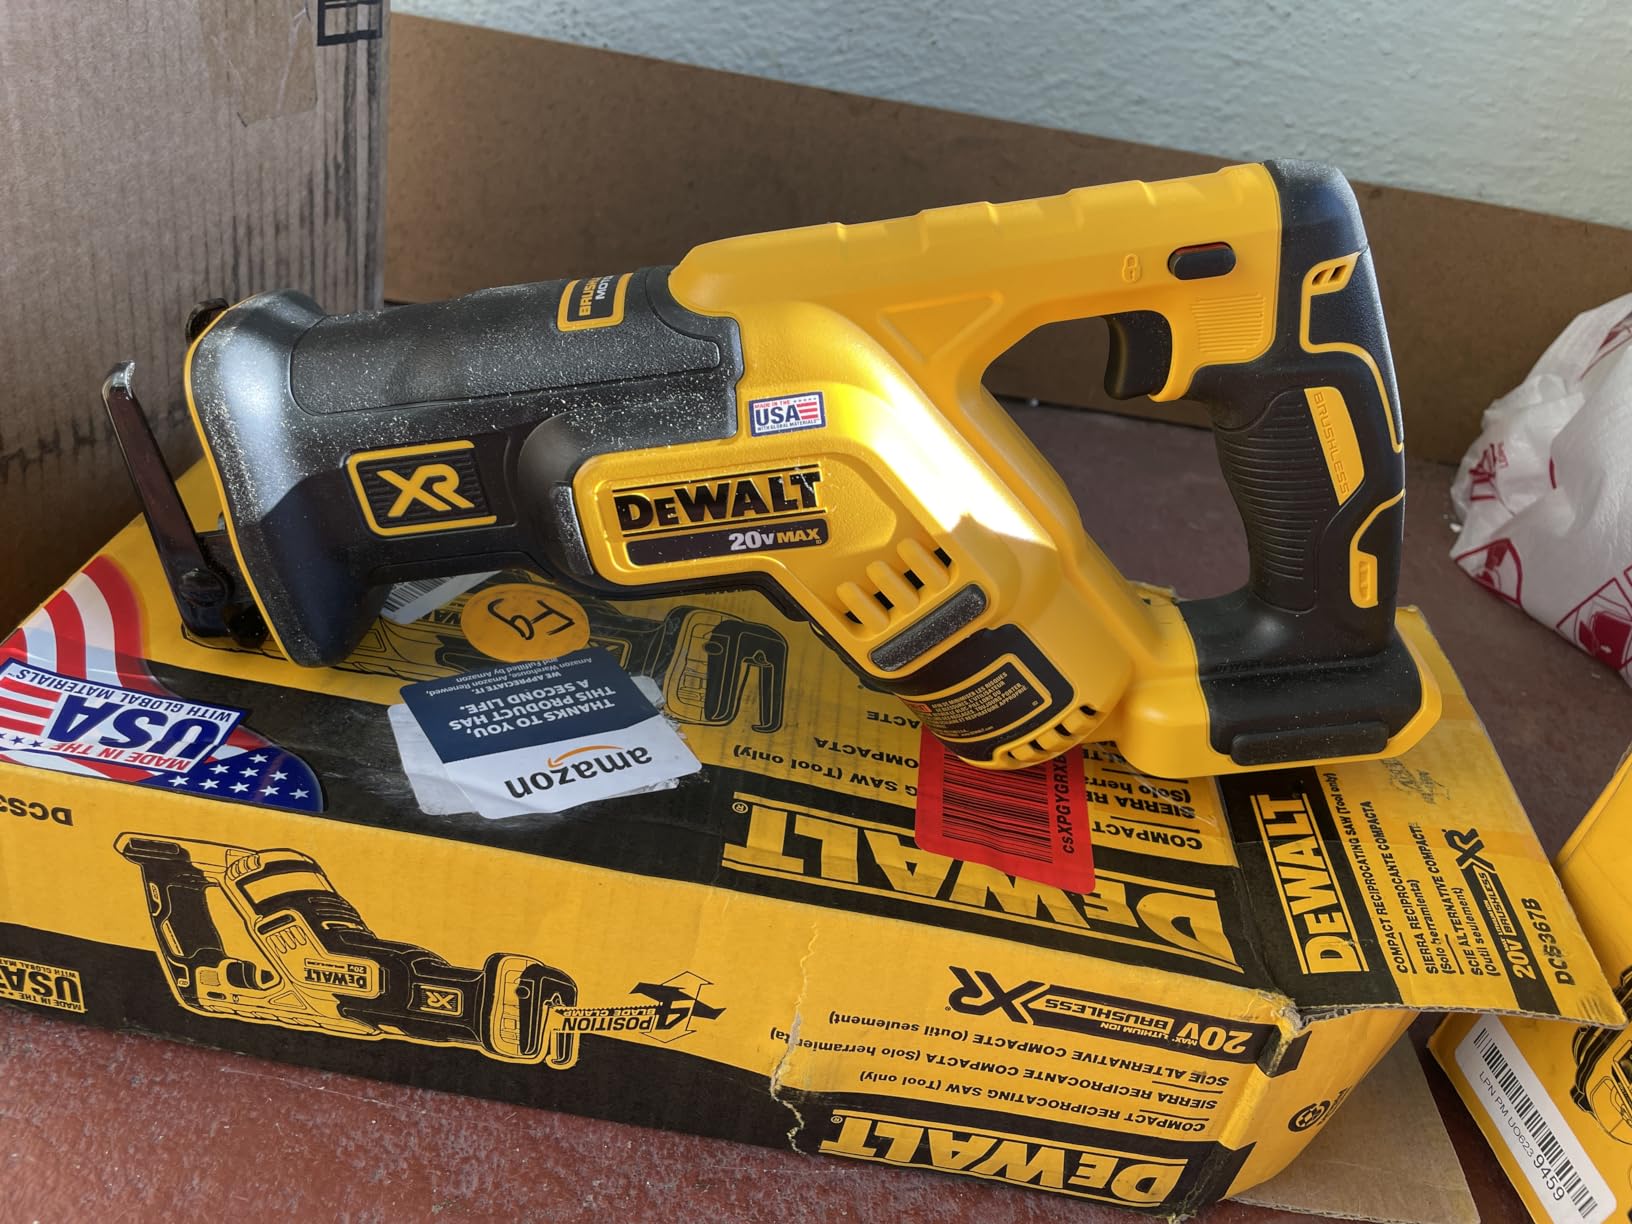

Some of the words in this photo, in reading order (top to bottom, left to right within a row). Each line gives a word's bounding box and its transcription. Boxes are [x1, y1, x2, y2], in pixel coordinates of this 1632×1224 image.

[755, 404, 800, 427] USA
[1313, 391, 1350, 494] BRUSHLESS
[377, 463, 478, 518] XR
[613, 471, 823, 532] DEWALT
[776, 528, 820, 544] MAX
[493, 666, 505, 675] by
[511, 663, 560, 680] Warehouse,
[558, 657, 592, 670] Amazon
[15, 669, 114, 699] MATERIALS
[456, 670, 493, 683] Amazon
[475, 674, 509, 688] Amazon
[485, 673, 544, 693] APPRECIATE
[543, 671, 563, 680] WE
[575, 679, 590, 689] A
[984, 671, 1008, 689] RISQUES
[426, 683, 474, 697] Renewed,
[471, 686, 486, 696] IT.
[506, 682, 577, 704] SECOND
[579, 685, 616, 703] THIS
[119, 692, 185, 713] GLOBAL
[459, 696, 505, 714] LIFE.
[492, 695, 575, 721] PRODUCT
[544, 698, 616, 721] THANKS
[186, 706, 233, 722] WITH
[448, 713, 490, 731] HAS
[516, 713, 544, 728] TO
[47, 694, 221, 760] USA
[466, 722, 516, 738] YOU,
[49, 742, 94, 755] THE
[97, 747, 125, 760] IN
[733, 744, 784, 765] only)
[813, 737, 919, 768] OMPACTA
[128, 751, 192, 771] MADE
[504, 745, 653, 799] amazon
[791, 758, 843, 780] (Tool
[849, 773, 899, 792] SAW
[1323, 772, 1340, 793] only)
[1114, 796, 1196, 819] SIERRA
[1331, 793, 1351, 815] (Tool
[1091, 820, 1203, 850] COMPACT
[1339, 815, 1357, 836] SAW
[1359, 800, 1390, 851] COMPACTA
[1444, 828, 1496, 872] XR
[723, 805, 1238, 967] DEWALT
[1258, 793, 1363, 974] DEWALT
[1348, 837, 1388, 916] RECIPROCATING
[1381, 852, 1422, 931] RECIPROCANTE
[1406, 879, 1441, 945] herramienta)
[1431, 876, 1472, 948] ALTERNATIVE
[1478, 872, 1514, 935] BRUSHLESS
[1451, 887, 1484, 945] seulement)
[1378, 917, 1408, 974] COMPACT
[1520, 897, 1577, 985] DCS367B
[1414, 933, 1439, 975] SIERRA
[1436, 947, 1456, 974] (Solo
[1463, 949, 1484, 976] SCIE
[1477, 947, 1502, 976] (Outil
[1506, 938, 1537, 980] 20V
[0, 965, 81, 1004] USA
[54, 969, 77, 979] WITH
[304, 968, 368, 990] DEWALT
[18, 992, 39, 1002] THE
[41, 996, 51, 1005] IN
[54, 999, 82, 1011] MADE
[425, 990, 455, 1009] XR
[948, 965, 1046, 1025] XR
[562, 1008, 613, 1018] CLAMP
[613, 1008, 657, 1017] BLADE
[828, 1010, 920, 1032] seulement)
[1045, 998, 1171, 1030] BRUSHLESS
[562, 1016, 651, 1032] POSITION
[924, 1025, 969, 1042] (Outil
[1100, 1022, 1122, 1033] ION
[1122, 1026, 1169, 1040] LITHIUM
[972, 1033, 1067, 1058] COMPACTE
[1177, 1022, 1253, 1054] 20V
[882, 1047, 922, 1062] (Solo
[926, 1052, 1019, 1076] COMPACTA
[1071, 1050, 1188, 1080] ALTERNATIVE
[860, 1070, 898, 1083] only)
[902, 1077, 942, 1091] (Tool
[1023, 1069, 1153, 1100] RECIPROCANTE
[1189, 1071, 1230, 1087] SCIE
[945, 1082, 984, 1097] SAW
[987, 1088, 1121, 1120] RECIPROCATING
[1157, 1092, 1218, 1110] SIERRA
[1123, 1111, 1206, 1133] COMPACT
[1479, 1070, 1497, 1097] LPN
[1494, 1096, 1510, 1118] PM
[1532, 1153, 1566, 1202] 9459
[818, 1115, 1187, 1204] DEWALT
